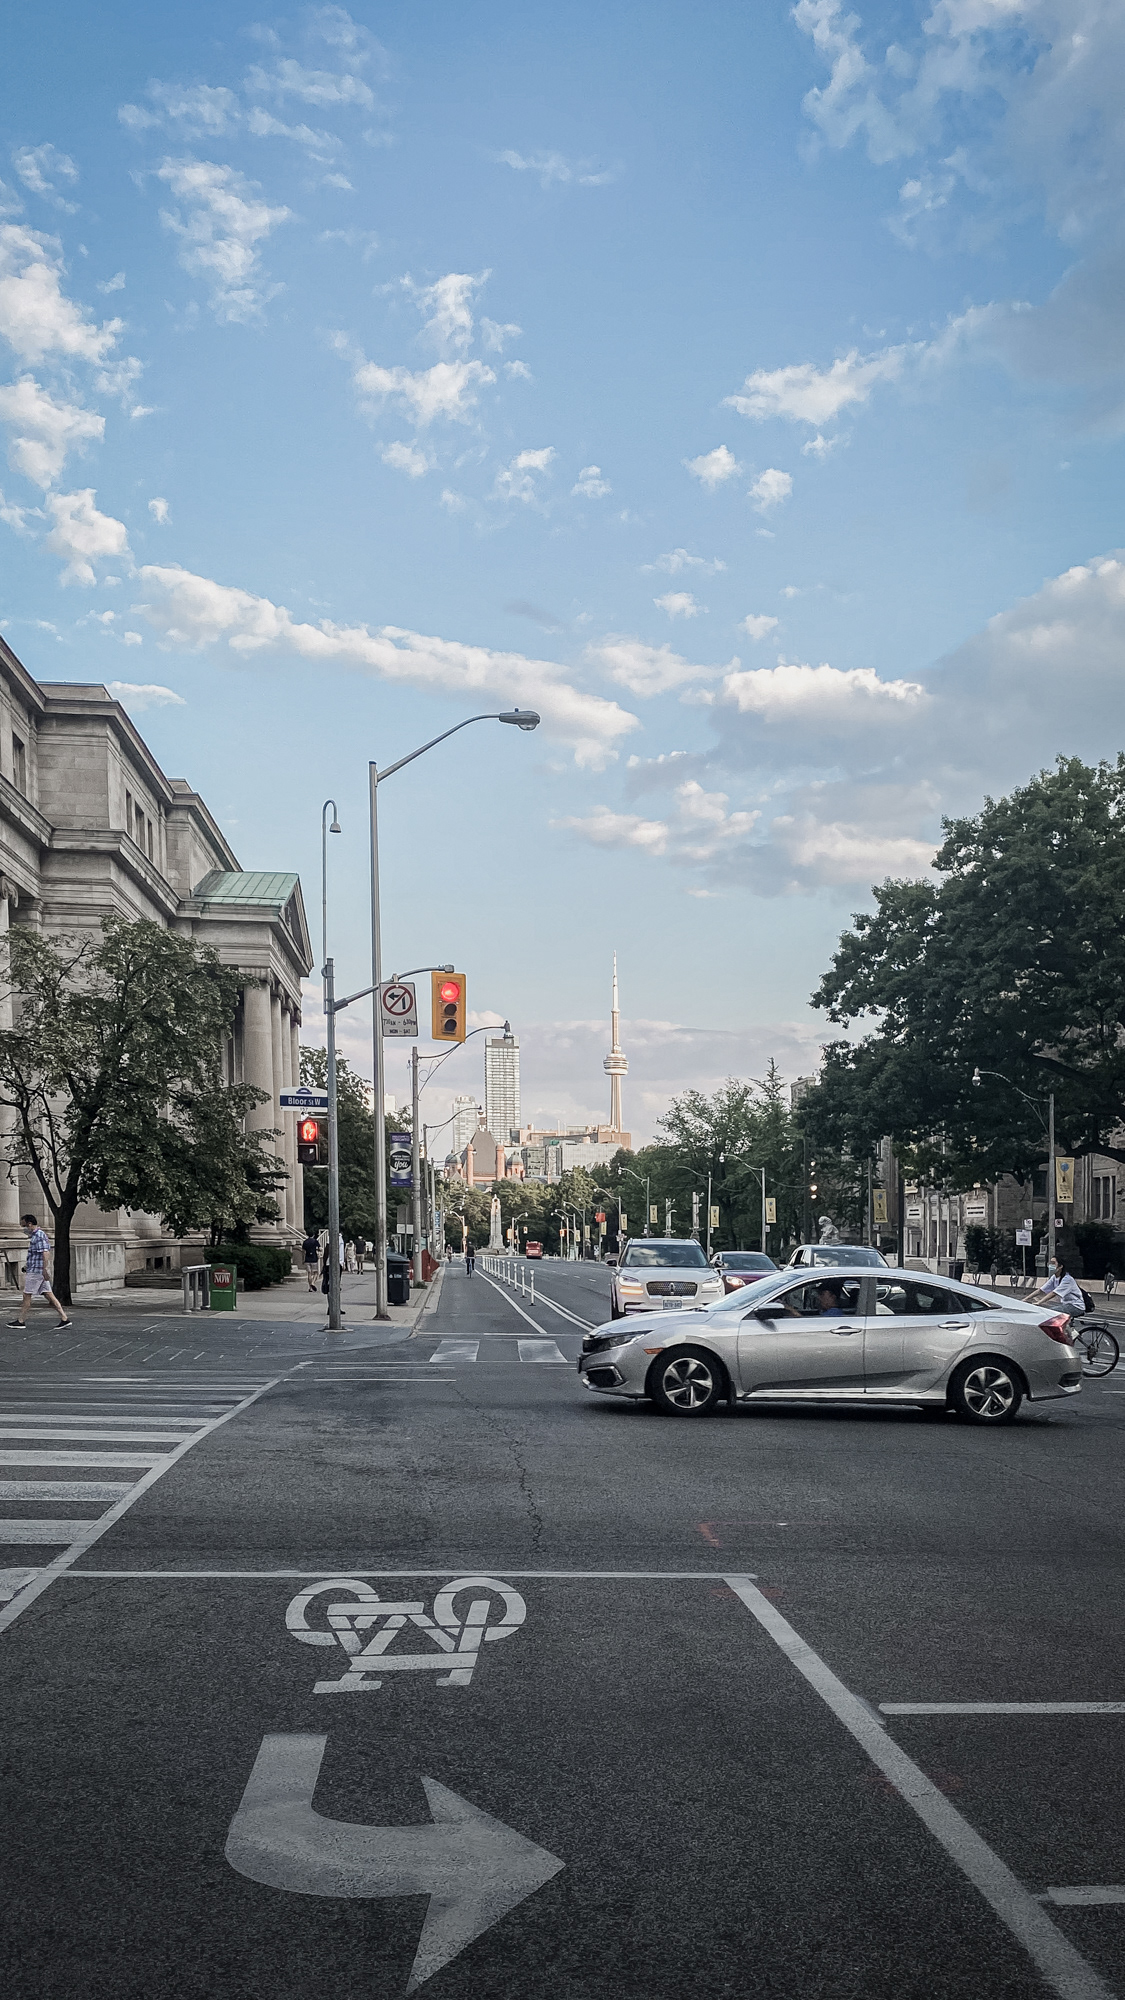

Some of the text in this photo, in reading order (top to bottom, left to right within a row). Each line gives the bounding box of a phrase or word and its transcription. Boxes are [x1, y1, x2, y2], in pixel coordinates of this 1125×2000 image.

[288, 1097, 307, 1105] Bloor
[394, 1161, 408, 1171] you
[214, 1272, 230, 1283] NOW
